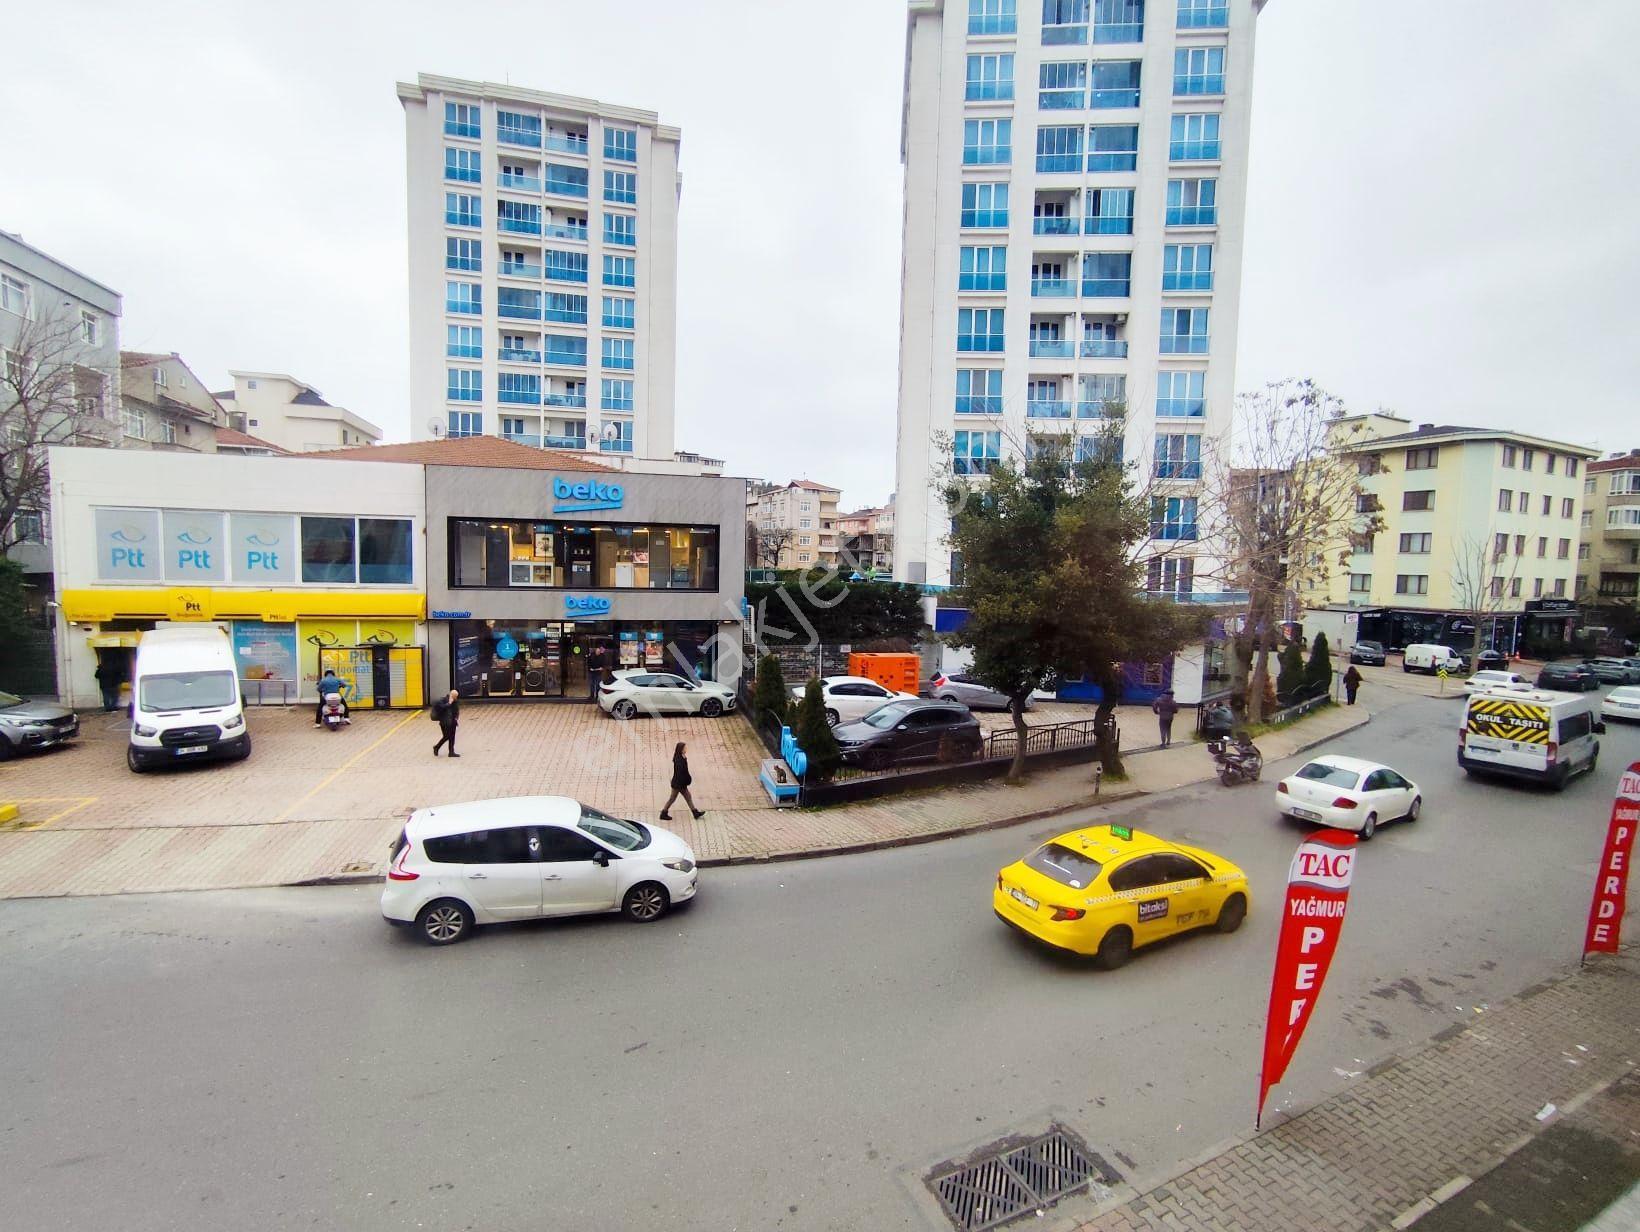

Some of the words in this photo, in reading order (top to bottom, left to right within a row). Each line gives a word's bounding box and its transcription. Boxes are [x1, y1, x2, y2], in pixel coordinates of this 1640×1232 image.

[554, 478, 624, 501] beko
[112, 548, 145, 567] Ptt
[179, 550, 211, 568] Ptt
[247, 551, 278, 570] Ptt
[186, 602, 200, 611] Ptt
[565, 596, 610, 609] beko
[1476, 713, 1504, 723] OKUL
[1593, 826, 1628, 942] PERDE
[1291, 896, 1345, 917] YAĞMUR
